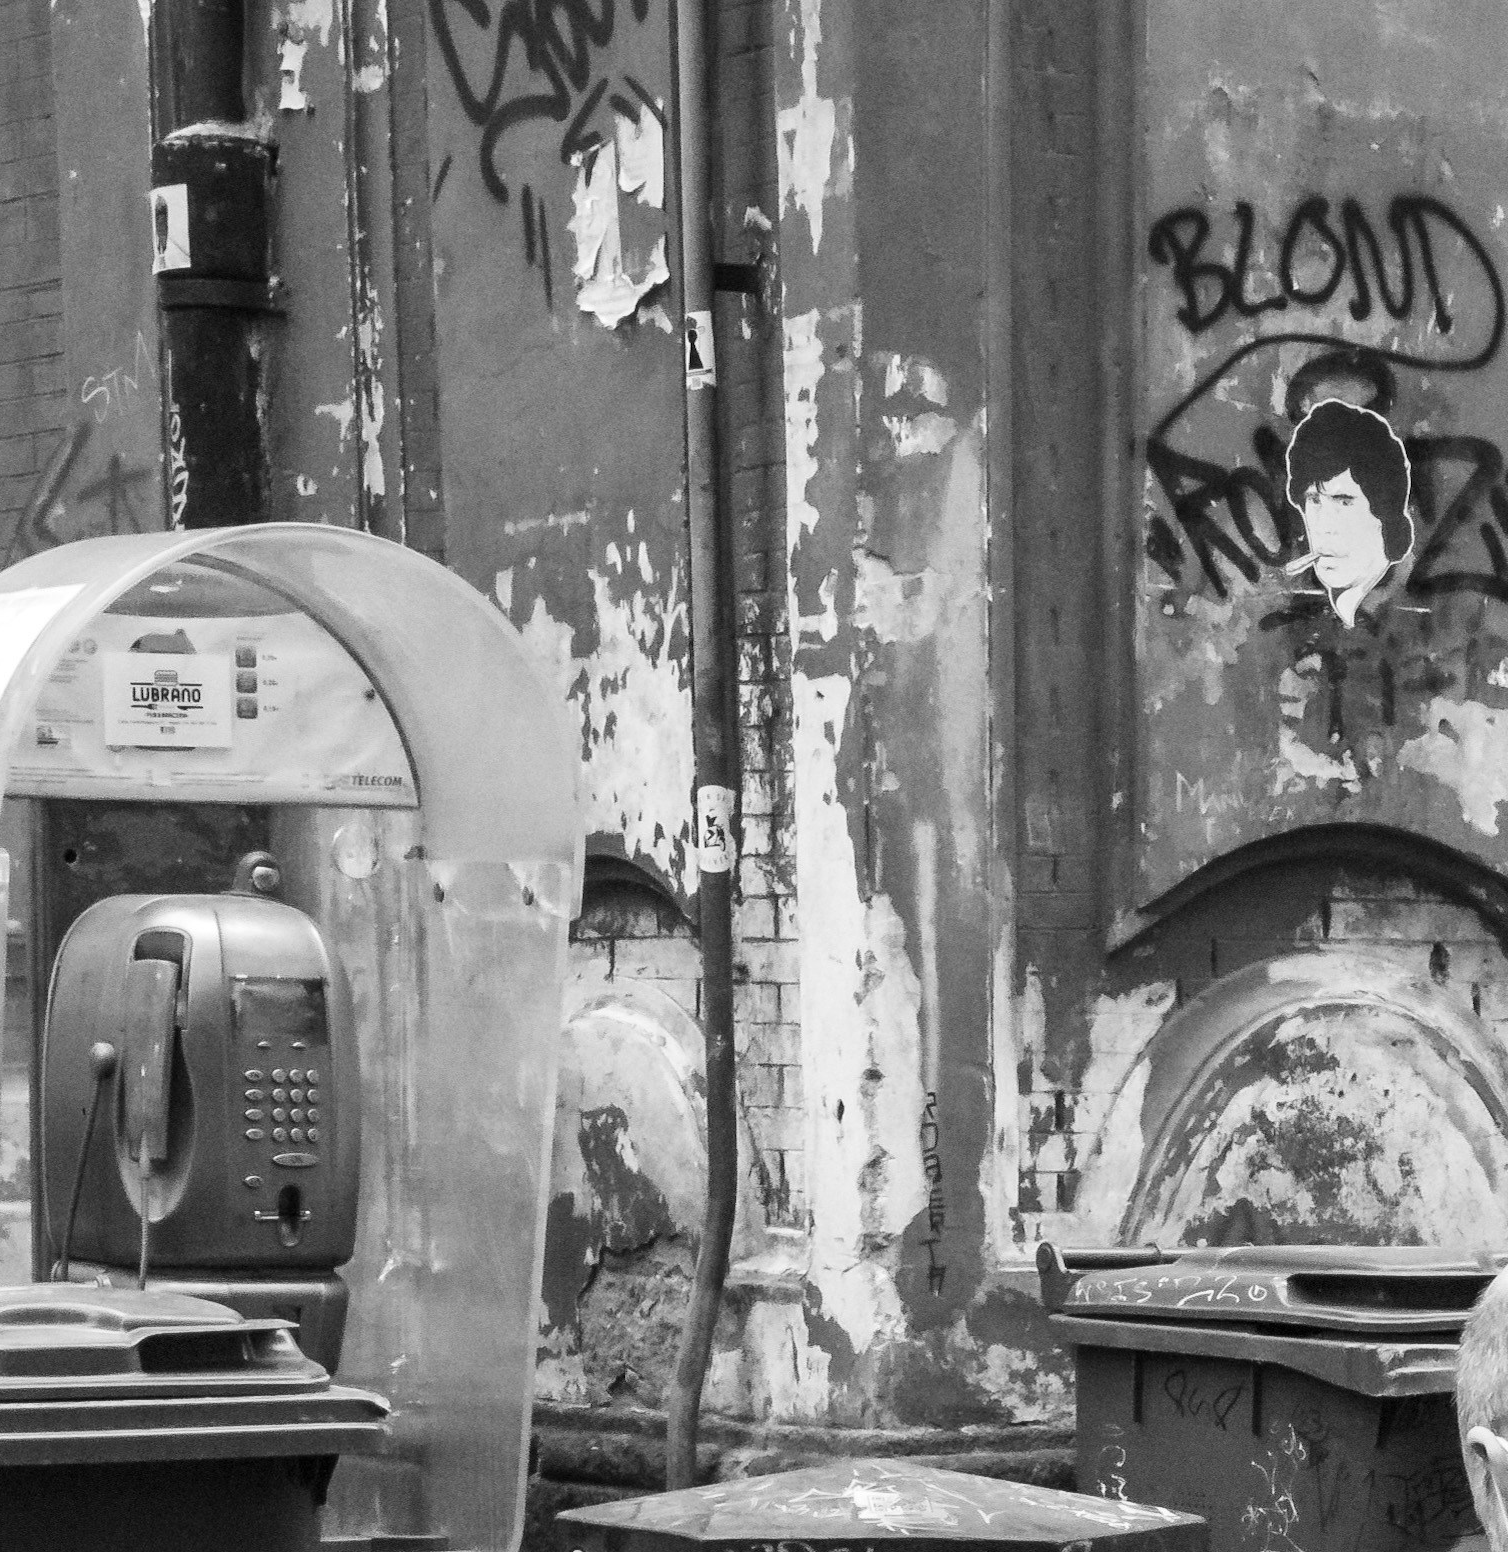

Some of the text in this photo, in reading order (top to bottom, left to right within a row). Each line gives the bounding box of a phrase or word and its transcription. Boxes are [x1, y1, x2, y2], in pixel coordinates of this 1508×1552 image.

[1148, 192, 1506, 350] BLOND
[132, 687, 201, 702] LUBRANO
[351, 774, 402, 786] TELECOM
